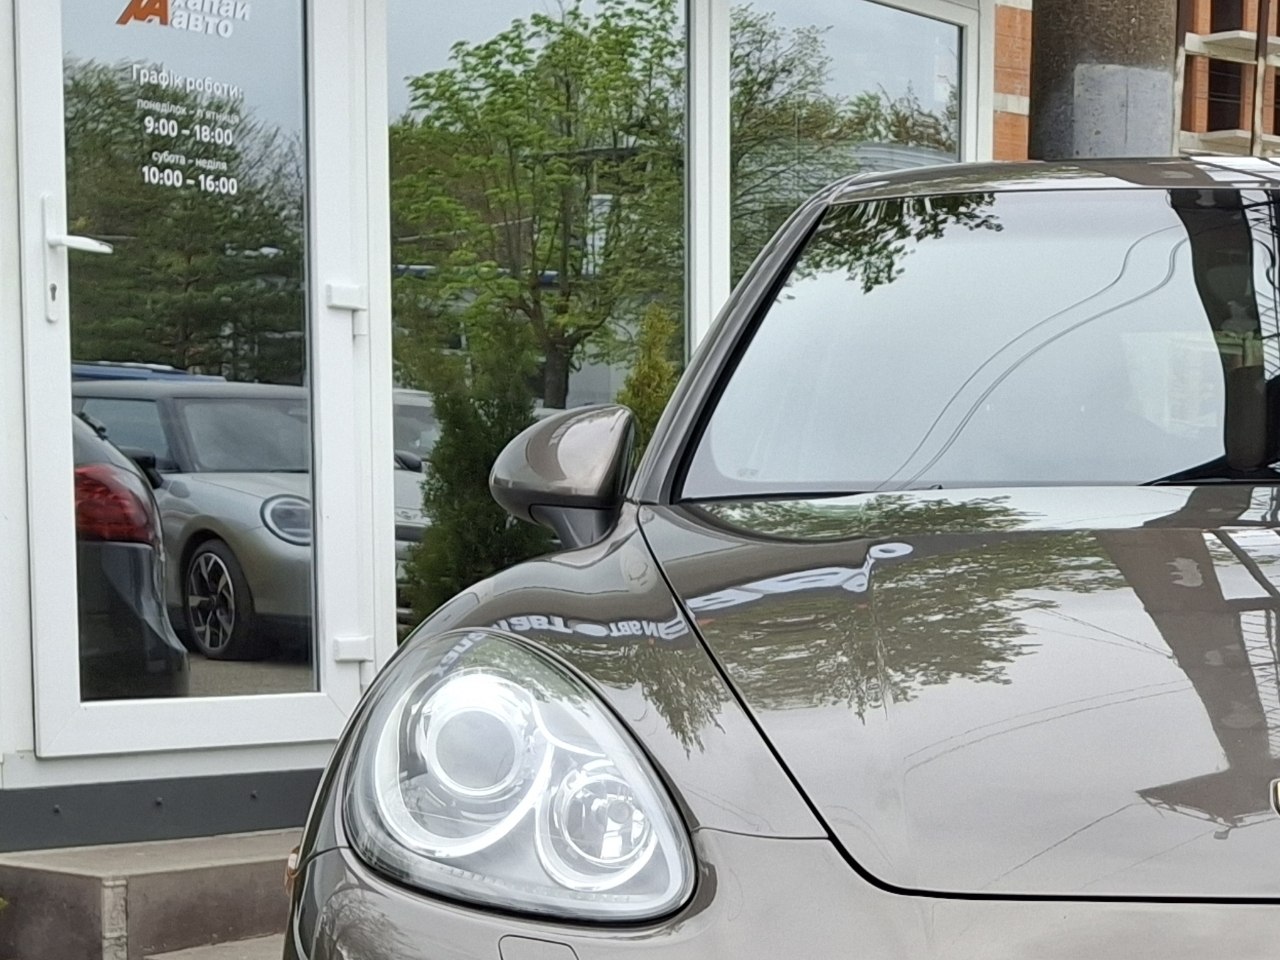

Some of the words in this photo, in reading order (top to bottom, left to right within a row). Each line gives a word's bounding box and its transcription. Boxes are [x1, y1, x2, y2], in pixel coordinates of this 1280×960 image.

[171, 10, 234, 39] авто
[132, 64, 183, 90] Графік
[186, 76, 244, 99] роботи:
[137, 99, 187, 116] понеділок
[144, 116, 178, 137] 9:00
[194, 124, 233, 146] 18:00
[152, 150, 186, 165] субота
[195, 158, 227, 171] неділя
[142, 165, 183, 188] 10:00
[198, 174, 238, 195] 16:00
